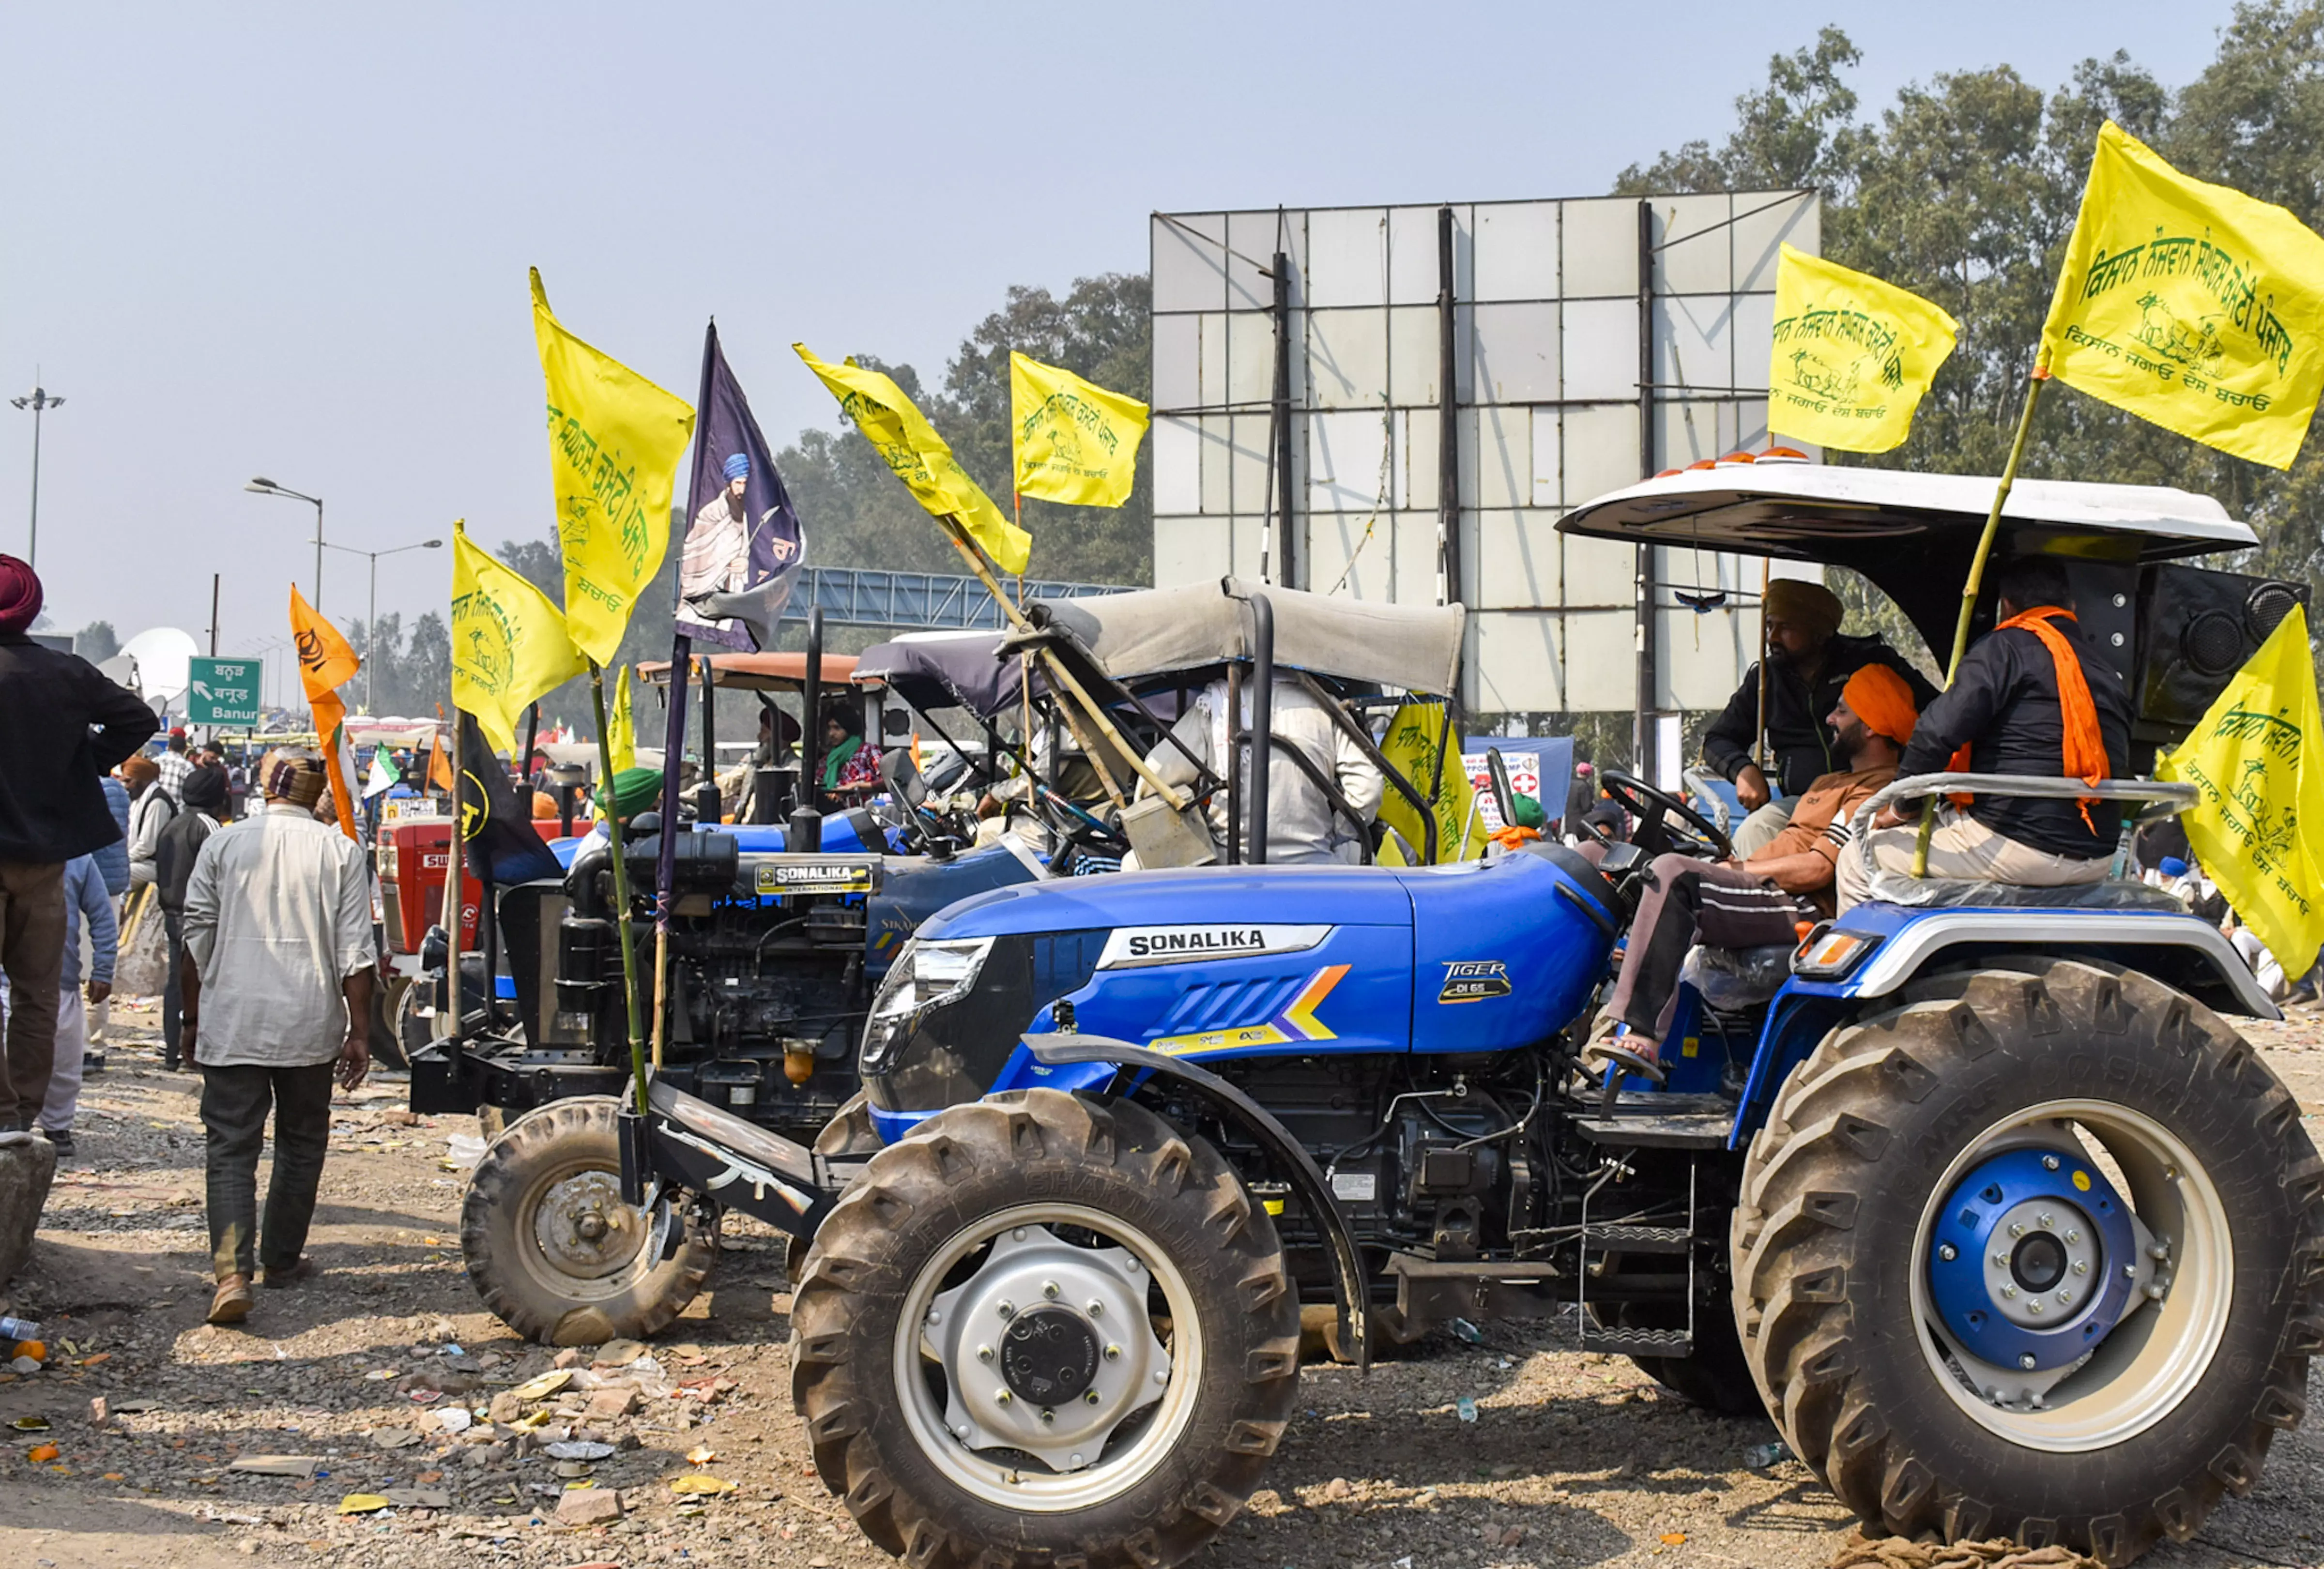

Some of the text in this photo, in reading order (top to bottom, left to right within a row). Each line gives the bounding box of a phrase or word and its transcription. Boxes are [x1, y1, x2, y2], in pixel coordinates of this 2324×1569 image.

[2079, 244, 2145, 305] ਕਿਸਾਨ
[2064, 324, 2123, 358] ਕਿਸਾਨ
[2125, 350, 2175, 381] ਜਗਾਓ
[212, 706, 258, 720] Banur
[776, 866, 852, 884] SONALIKA
[1130, 929, 1266, 956] SONALIKA
[1441, 960, 1509, 982] TIGER
[1456, 983, 1485, 993] DI 65
